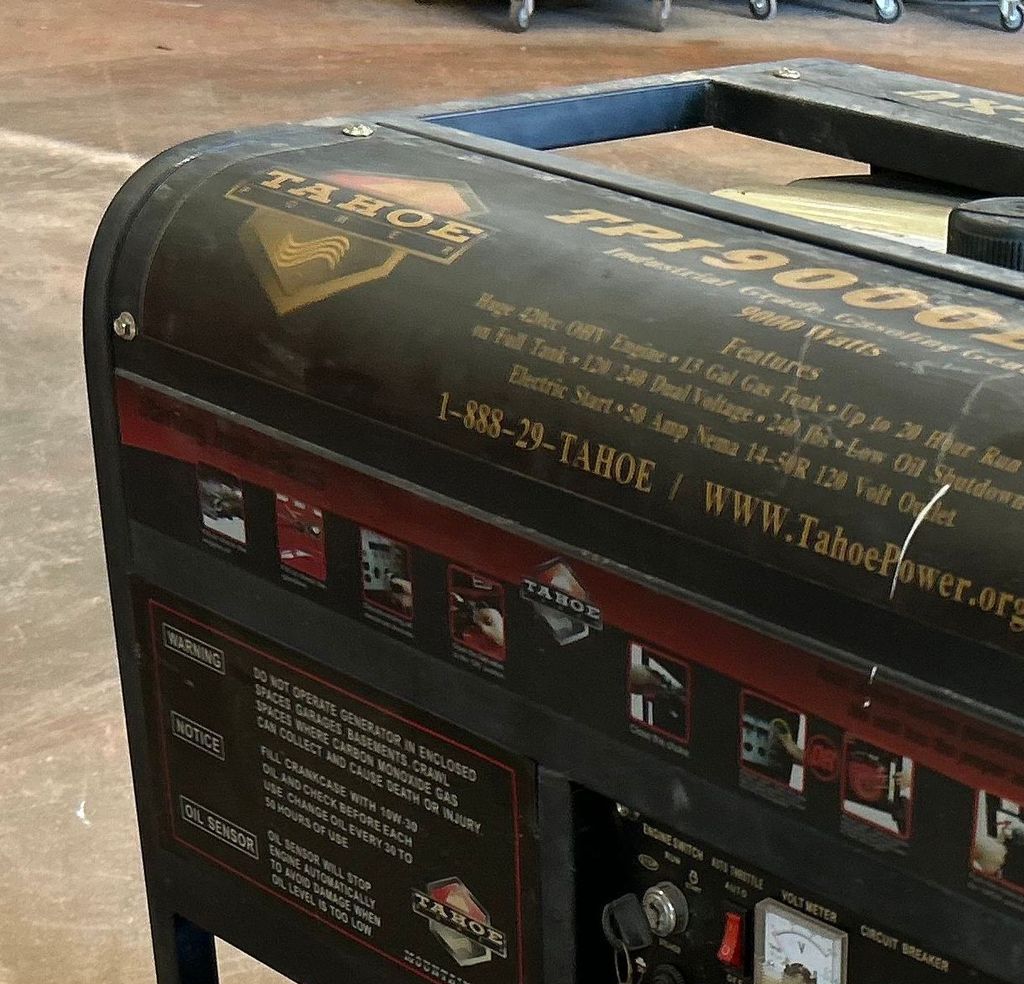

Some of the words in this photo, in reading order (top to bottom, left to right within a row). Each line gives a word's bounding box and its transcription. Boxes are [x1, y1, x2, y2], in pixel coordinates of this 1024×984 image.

[261, 169, 485, 243] TAHOE
[604, 248, 736, 287] Industrial
[722, 337, 823, 380] Features
[741, 306, 806, 332] 9000
[805, 324, 881, 357] Watts
[438, 391, 656, 493] 1-888-29-TAHOE
[508, 363, 568, 399] Electric
[651, 411, 689, 443] Amp
[855, 475, 892, 506] Volt
[704, 363, 739, 387] Gal
[740, 374, 774, 398] Gas
[779, 385, 821, 413] Tank
[839, 403, 866, 427] Up
[869, 416, 891, 433] to
[924, 430, 976, 458] Hour
[979, 446, 1023, 473] Run
[846, 438, 887, 464] Low
[892, 453, 927, 478] Oil
[524, 579, 600, 620] TAHOE
[167, 629, 222, 669] WARNING
[176, 717, 221, 753] NOTICE
[253, 667, 267, 682] DO
[269, 674, 290, 692] NOT
[292, 686, 337, 717] OPERATE
[340, 708, 401, 747] GENERATOR
[404, 738, 416, 754] IN
[418, 745, 477, 782] ENCLOSED
[255, 683, 291, 710] SPACES
[295, 703, 342, 735] GARAGES
[347, 727, 408, 766] BASEMENTS
[411, 759, 450, 788] CRAWL
[256, 700, 292, 727] SPACES
[295, 718, 329, 745] WHERE
[332, 737, 374, 767] CARBON
[377, 758, 432, 795] MONOXIDE
[435, 786, 458, 807] GAS
[257, 716, 277, 734] CAN
[280, 727, 322, 756] COLLECT
[326, 750, 347, 768] AND
[349, 761, 383, 788] CAUSE
[386, 778, 420, 805] DEATH
[424, 798, 439, 815] OR
[441, 806, 482, 835] INJURY
[260, 745, 281, 765] FILL
[284, 758, 347, 797] CRANKCASE
[350, 791, 376, 812] WITH
[262, 763, 279, 779] OIL
[280, 773, 301, 790] AND
[302, 784, 338, 809] CHECK
[339, 803, 382, 832] BEFORE
[382, 824, 413, 847] EACH
[185, 804, 203, 825] OIL
[208, 816, 255, 853] SENSOR
[263, 779, 284, 798] USE
[286, 792, 329, 821] CHANGE
[330, 815, 347, 832] OIL
[348, 824, 382, 848] EVERY
[396, 848, 413, 864] TO
[276, 801, 311, 829] HOURS
[312, 821, 326, 835] OF
[327, 829, 349, 849] USE
[267, 830, 282, 846] OIL
[284, 839, 320, 866] SENSOR
[321, 859, 345, 880] WILL
[346, 872, 372, 892] STOP
[269, 844, 301, 870] ENGINE
[304, 864, 376, 910] AUTOMATICALLY
[271, 859, 282, 873] TO
[285, 868, 311, 889] AVOID
[313, 881, 352, 912] DAMAGE
[353, 904, 381, 927] WHEN
[271, 873, 287, 890] OIL
[288, 882, 316, 906] LEVEL
[318, 899, 328, 912] IS
[329, 904, 349, 924] TOO
[350, 916, 372, 936] LOW
[414, 892, 503, 945] TAHOE
[780, 889, 805, 909] VOLT
[805, 900, 838, 924] METER
[860, 924, 898, 950] CIRCUIT
[902, 942, 950, 972] BREAKER
